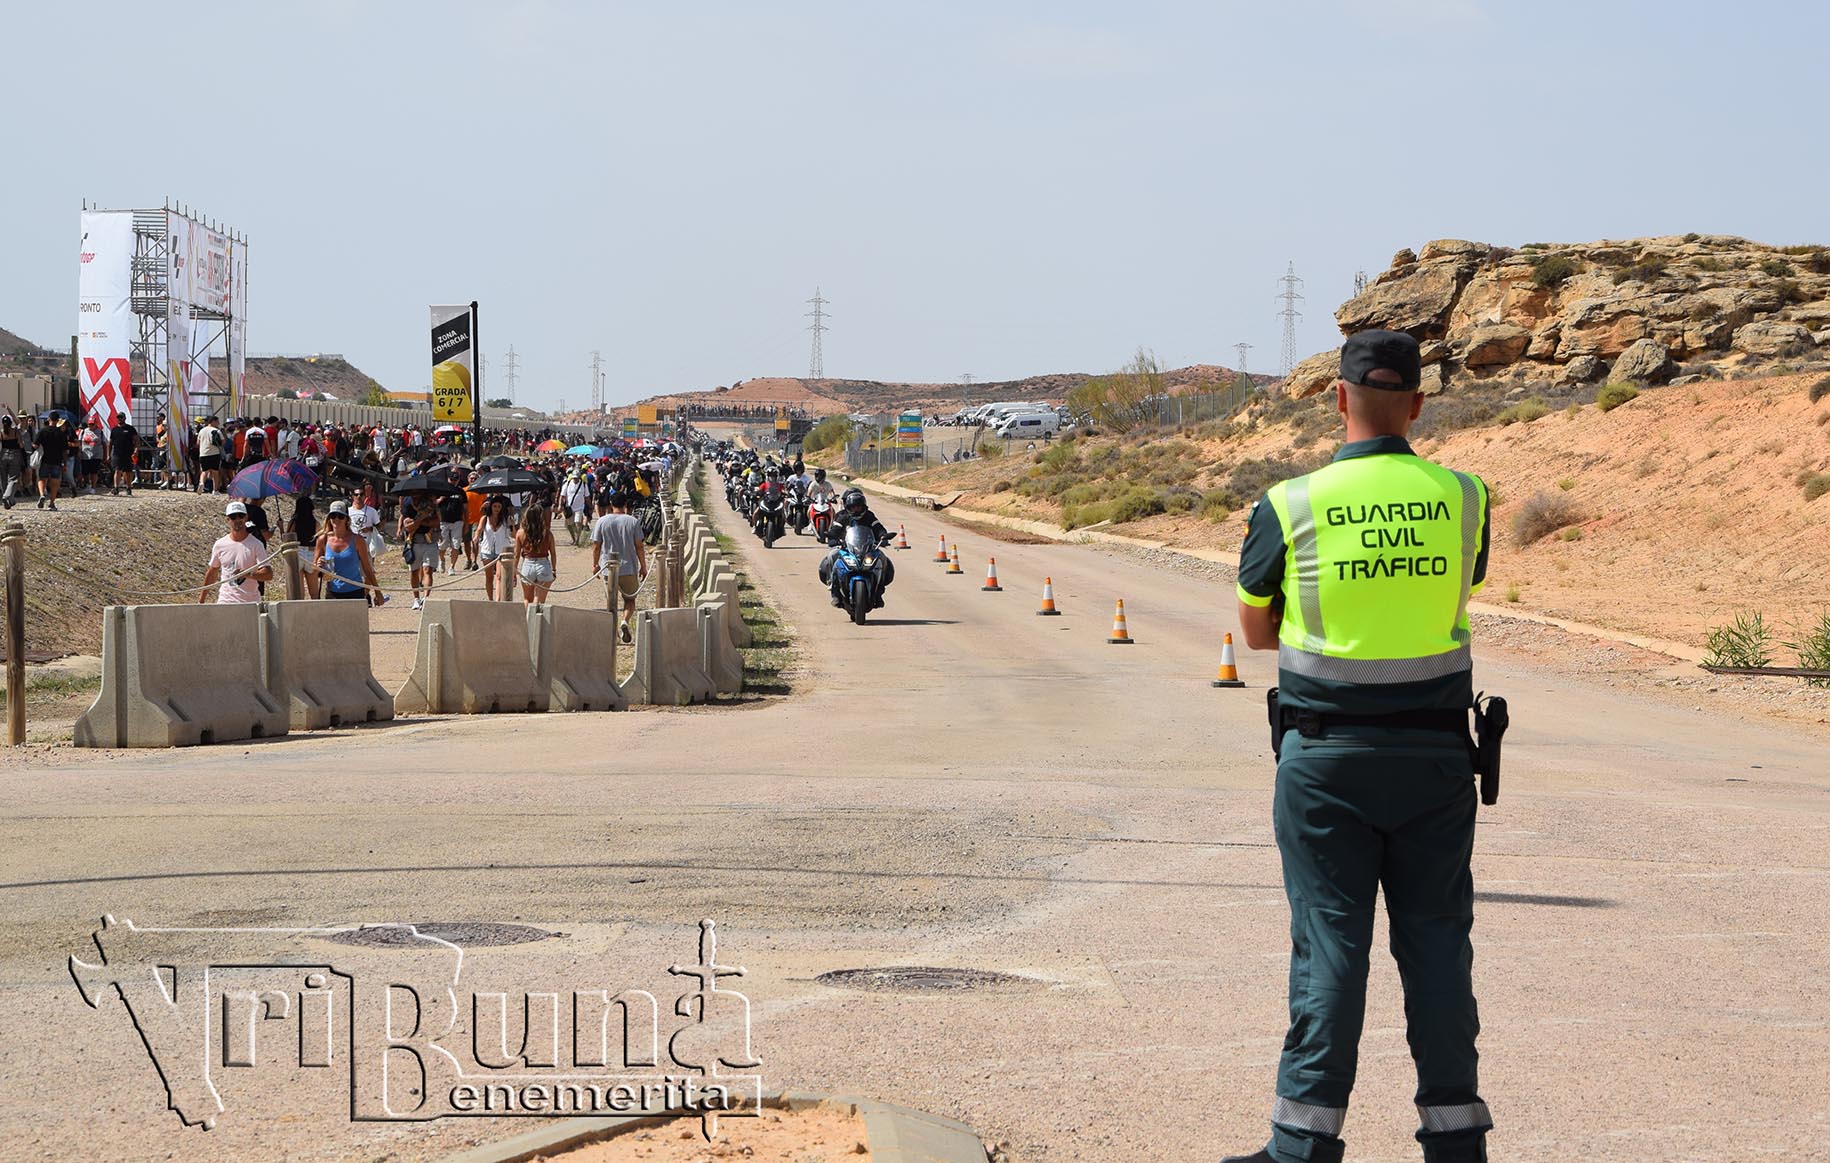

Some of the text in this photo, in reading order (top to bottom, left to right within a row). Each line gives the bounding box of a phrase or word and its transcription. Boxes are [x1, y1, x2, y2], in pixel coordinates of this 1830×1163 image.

[433, 333, 468, 353] COMERCIAL
[438, 330, 457, 343] ZONA
[435, 387, 466, 396] GRADA
[1327, 501, 1450, 526] GUARDIA
[1360, 527, 1424, 549] CIVIL
[1334, 554, 1447, 580] TRÁFICO
